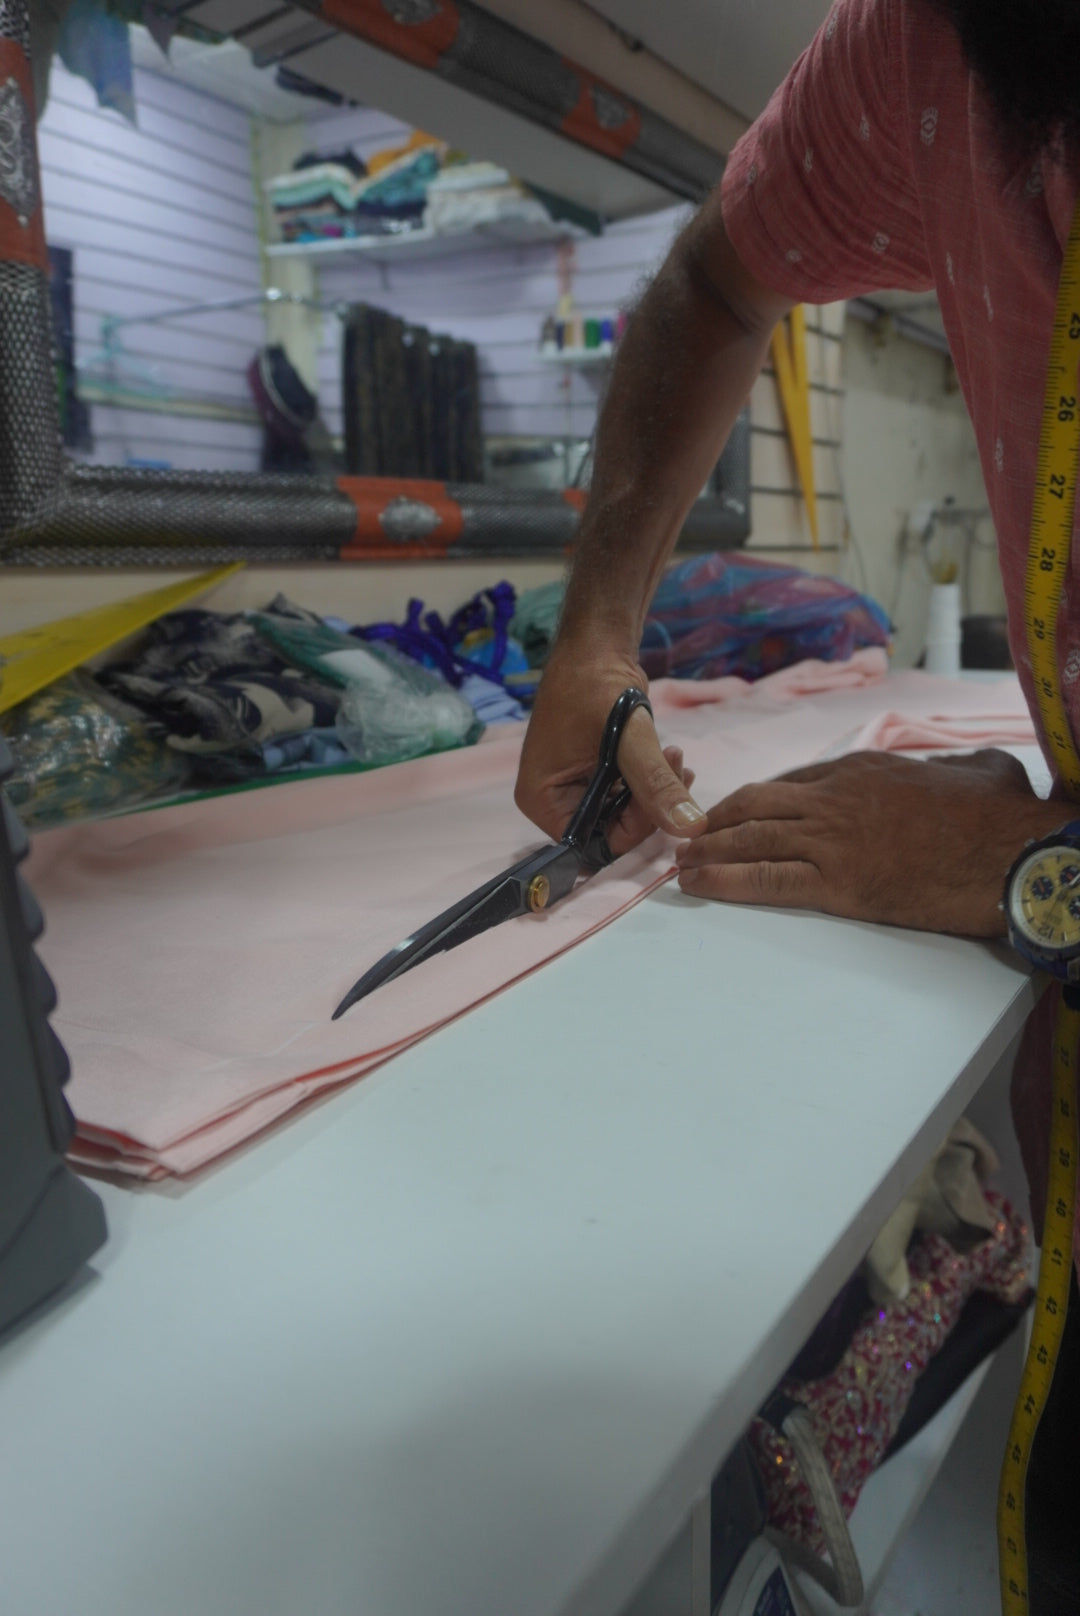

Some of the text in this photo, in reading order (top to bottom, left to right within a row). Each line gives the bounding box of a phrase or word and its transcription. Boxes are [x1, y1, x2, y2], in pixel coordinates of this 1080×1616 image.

[1069, 312, 1080, 340] 25
[1057, 396, 1076, 422] 26
[1049, 473, 1066, 500] 27
[1040, 547, 1056, 572] 28
[1033, 617, 1045, 640] 29
[1041, 677, 1054, 698] 30
[1052, 731, 1066, 749] 31
[1059, 1147, 1071, 1168] 39
[1056, 1197, 1068, 1218] 40
[1051, 1247, 1063, 1266] 41
[1046, 1296, 1058, 1315] 42
[1037, 1345, 1049, 1365] 43
[1024, 1394, 1036, 1415] 44
[1012, 1445, 1022, 1464] 45
